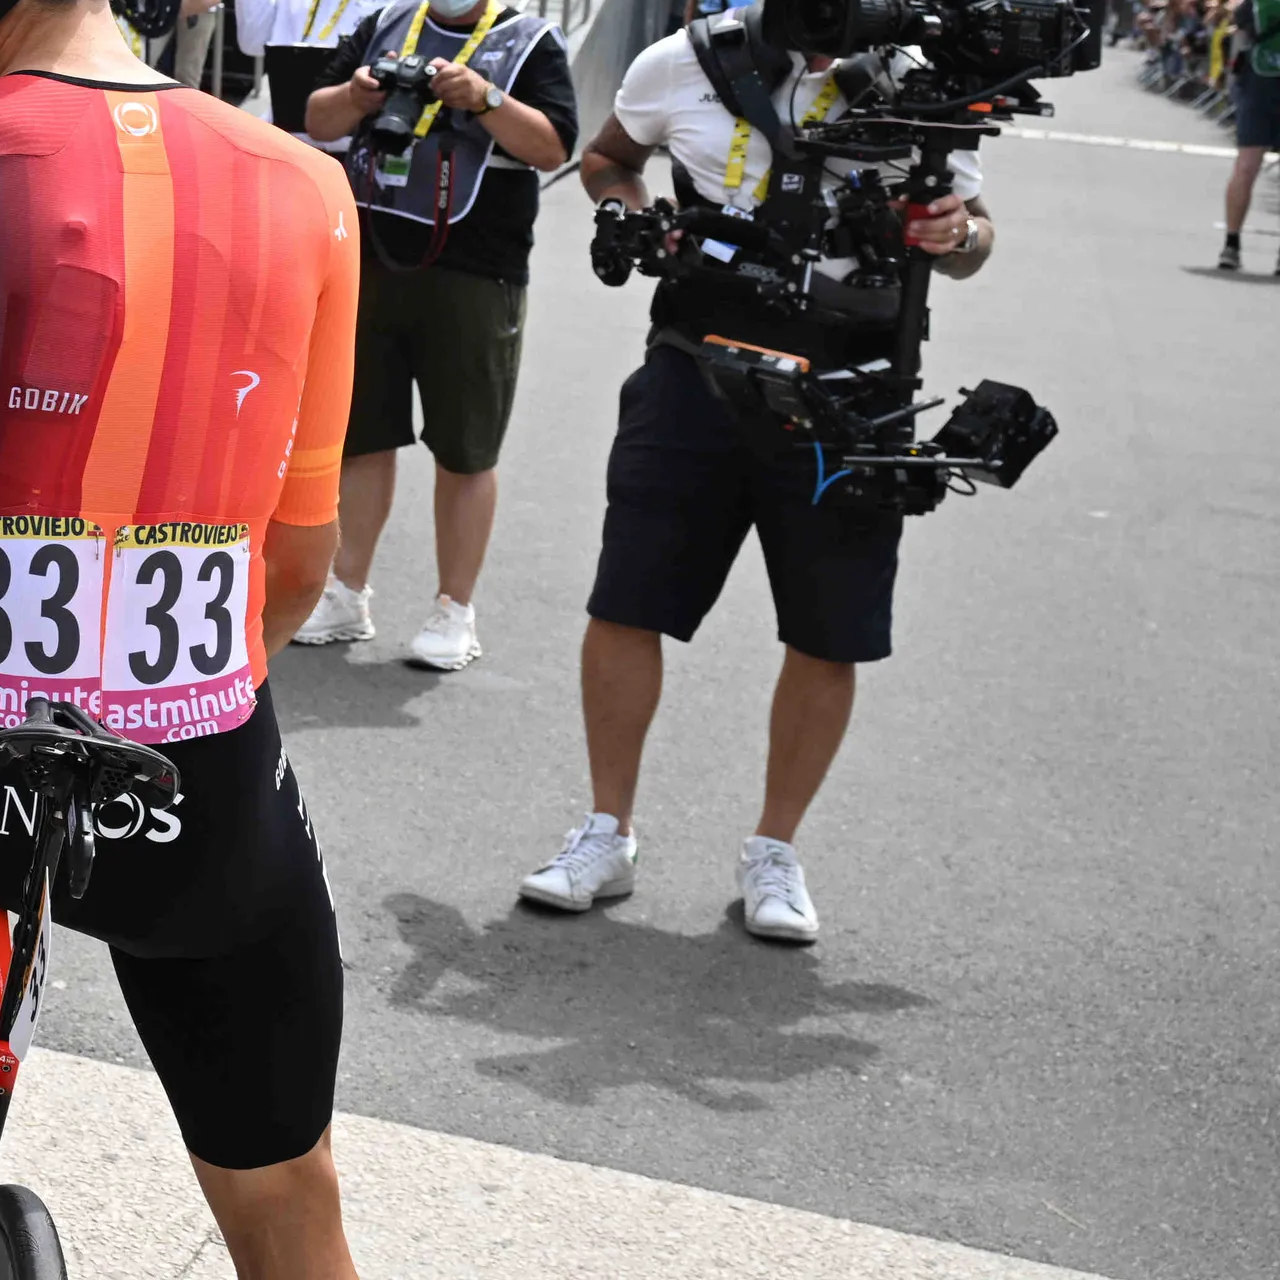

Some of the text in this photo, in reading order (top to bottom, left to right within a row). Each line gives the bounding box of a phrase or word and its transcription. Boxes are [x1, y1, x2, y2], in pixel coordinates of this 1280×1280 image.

[8, 387, 89, 415] GOBIK
[135, 524, 238, 546] CASTROVIEJO
[128, 550, 235, 685] 33
